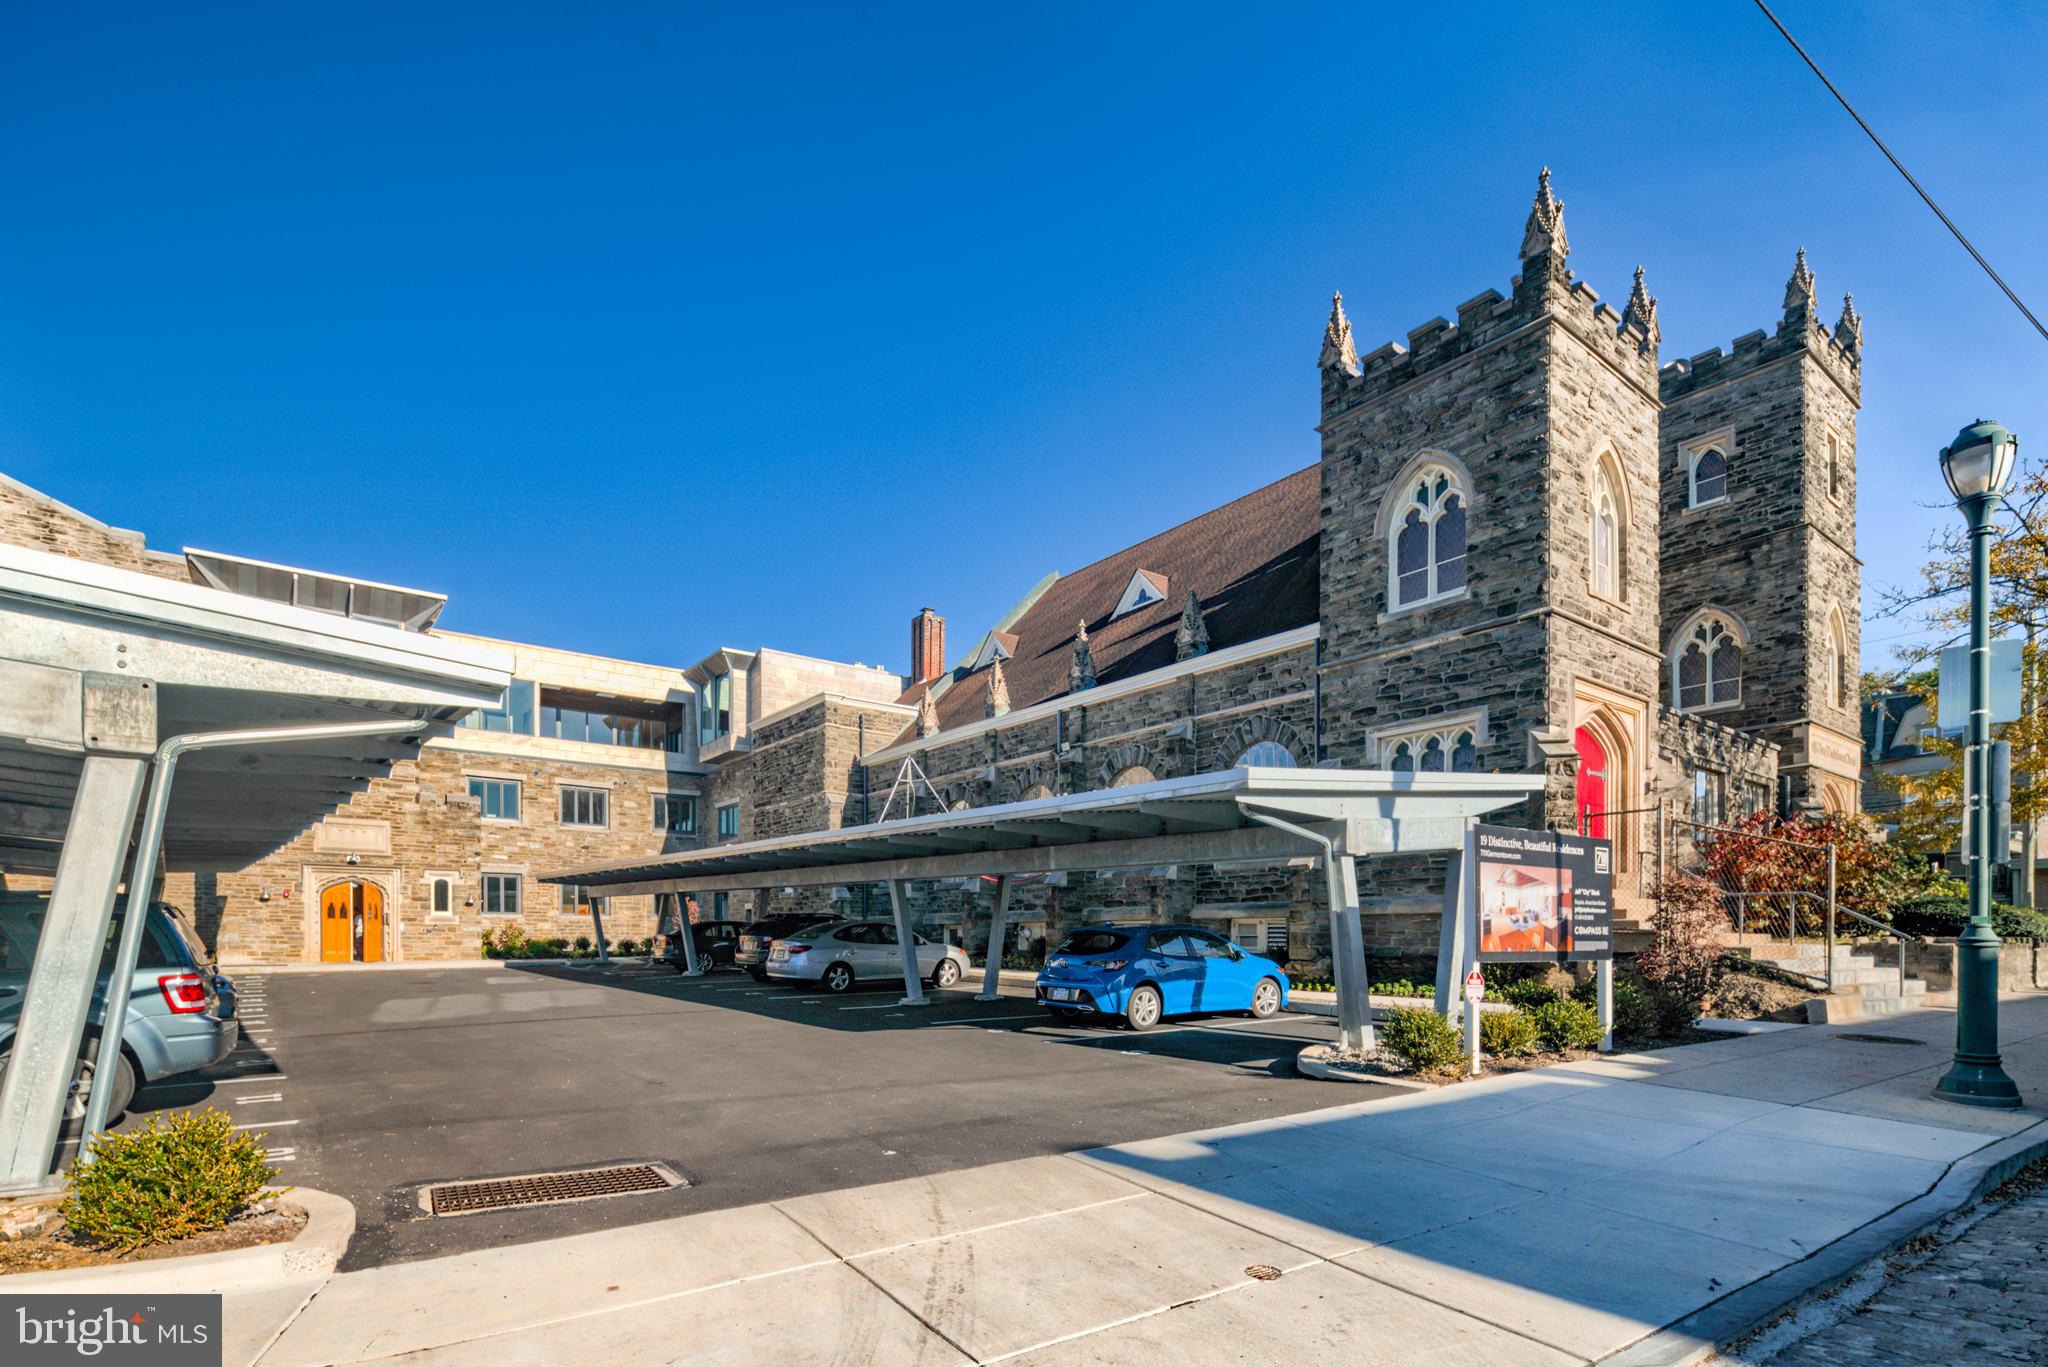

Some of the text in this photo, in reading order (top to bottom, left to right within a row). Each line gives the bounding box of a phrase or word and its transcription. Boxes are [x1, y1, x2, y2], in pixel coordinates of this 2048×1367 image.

[1480, 834, 1488, 845] 19
[1488, 835, 1523, 850] Distinctive,
[1524, 839, 1552, 853] Beautiful
[1574, 925, 1602, 936] COMPASS
